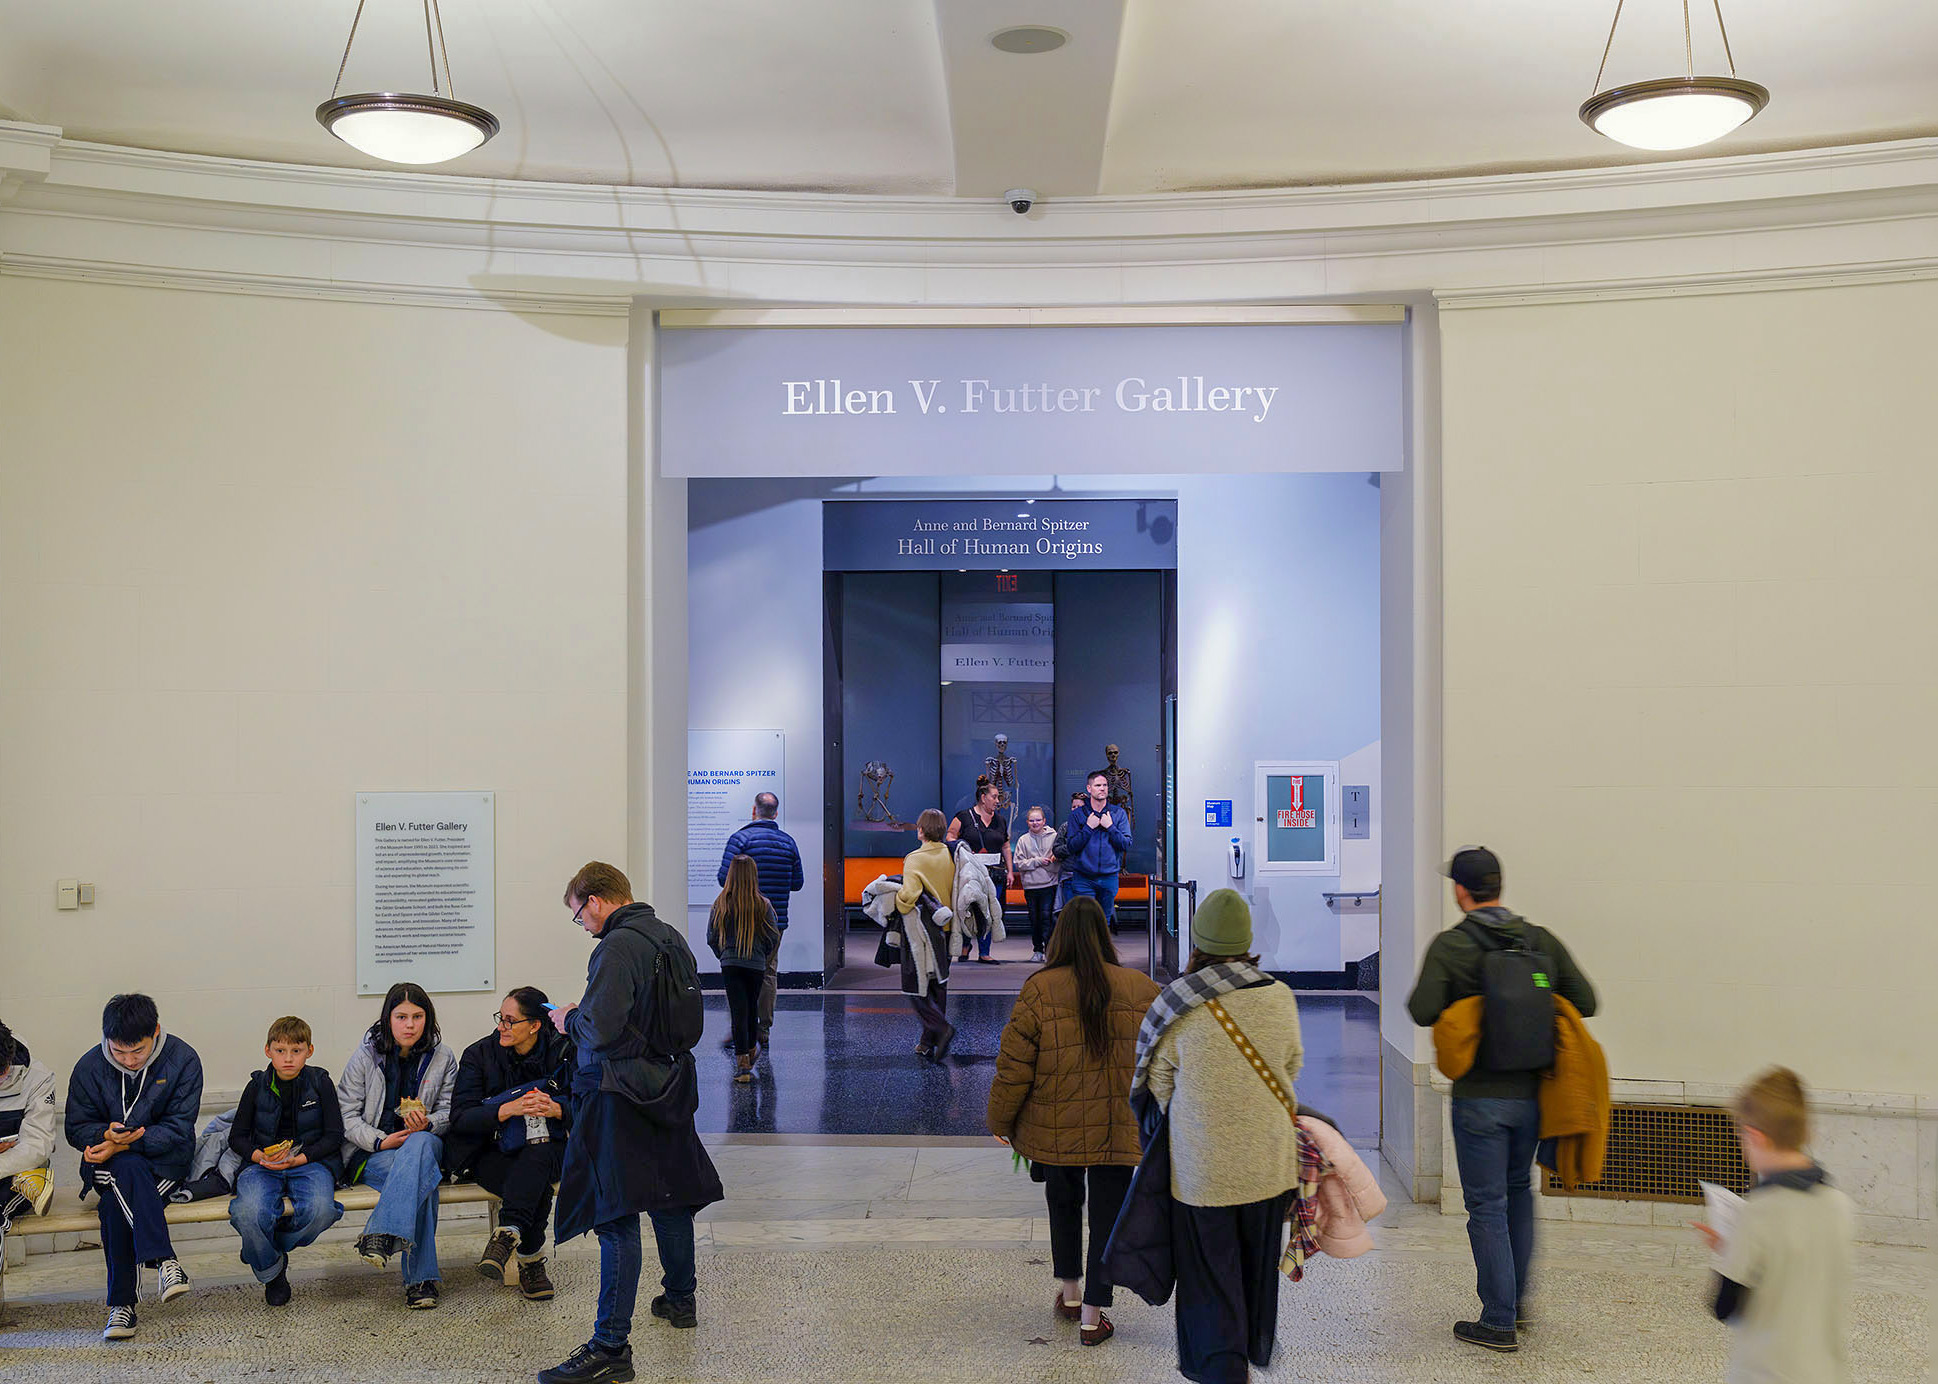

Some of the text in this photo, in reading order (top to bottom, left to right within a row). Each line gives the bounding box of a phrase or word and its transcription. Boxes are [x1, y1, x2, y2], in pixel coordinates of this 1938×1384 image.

[782, 376, 1279, 422] Ellen V. Futter Gallery
[913, 518, 1090, 534] Anne and Bernard Spitzer
[897, 538, 1102, 559] Hall of Human Origins
[956, 658, 1050, 666] Ellen V. Futter
[1351, 792, 1360, 802] T
[1278, 810, 1314, 819] FIRE HOSE
[375, 822, 467, 832] Ellen V. Futter Gallery
